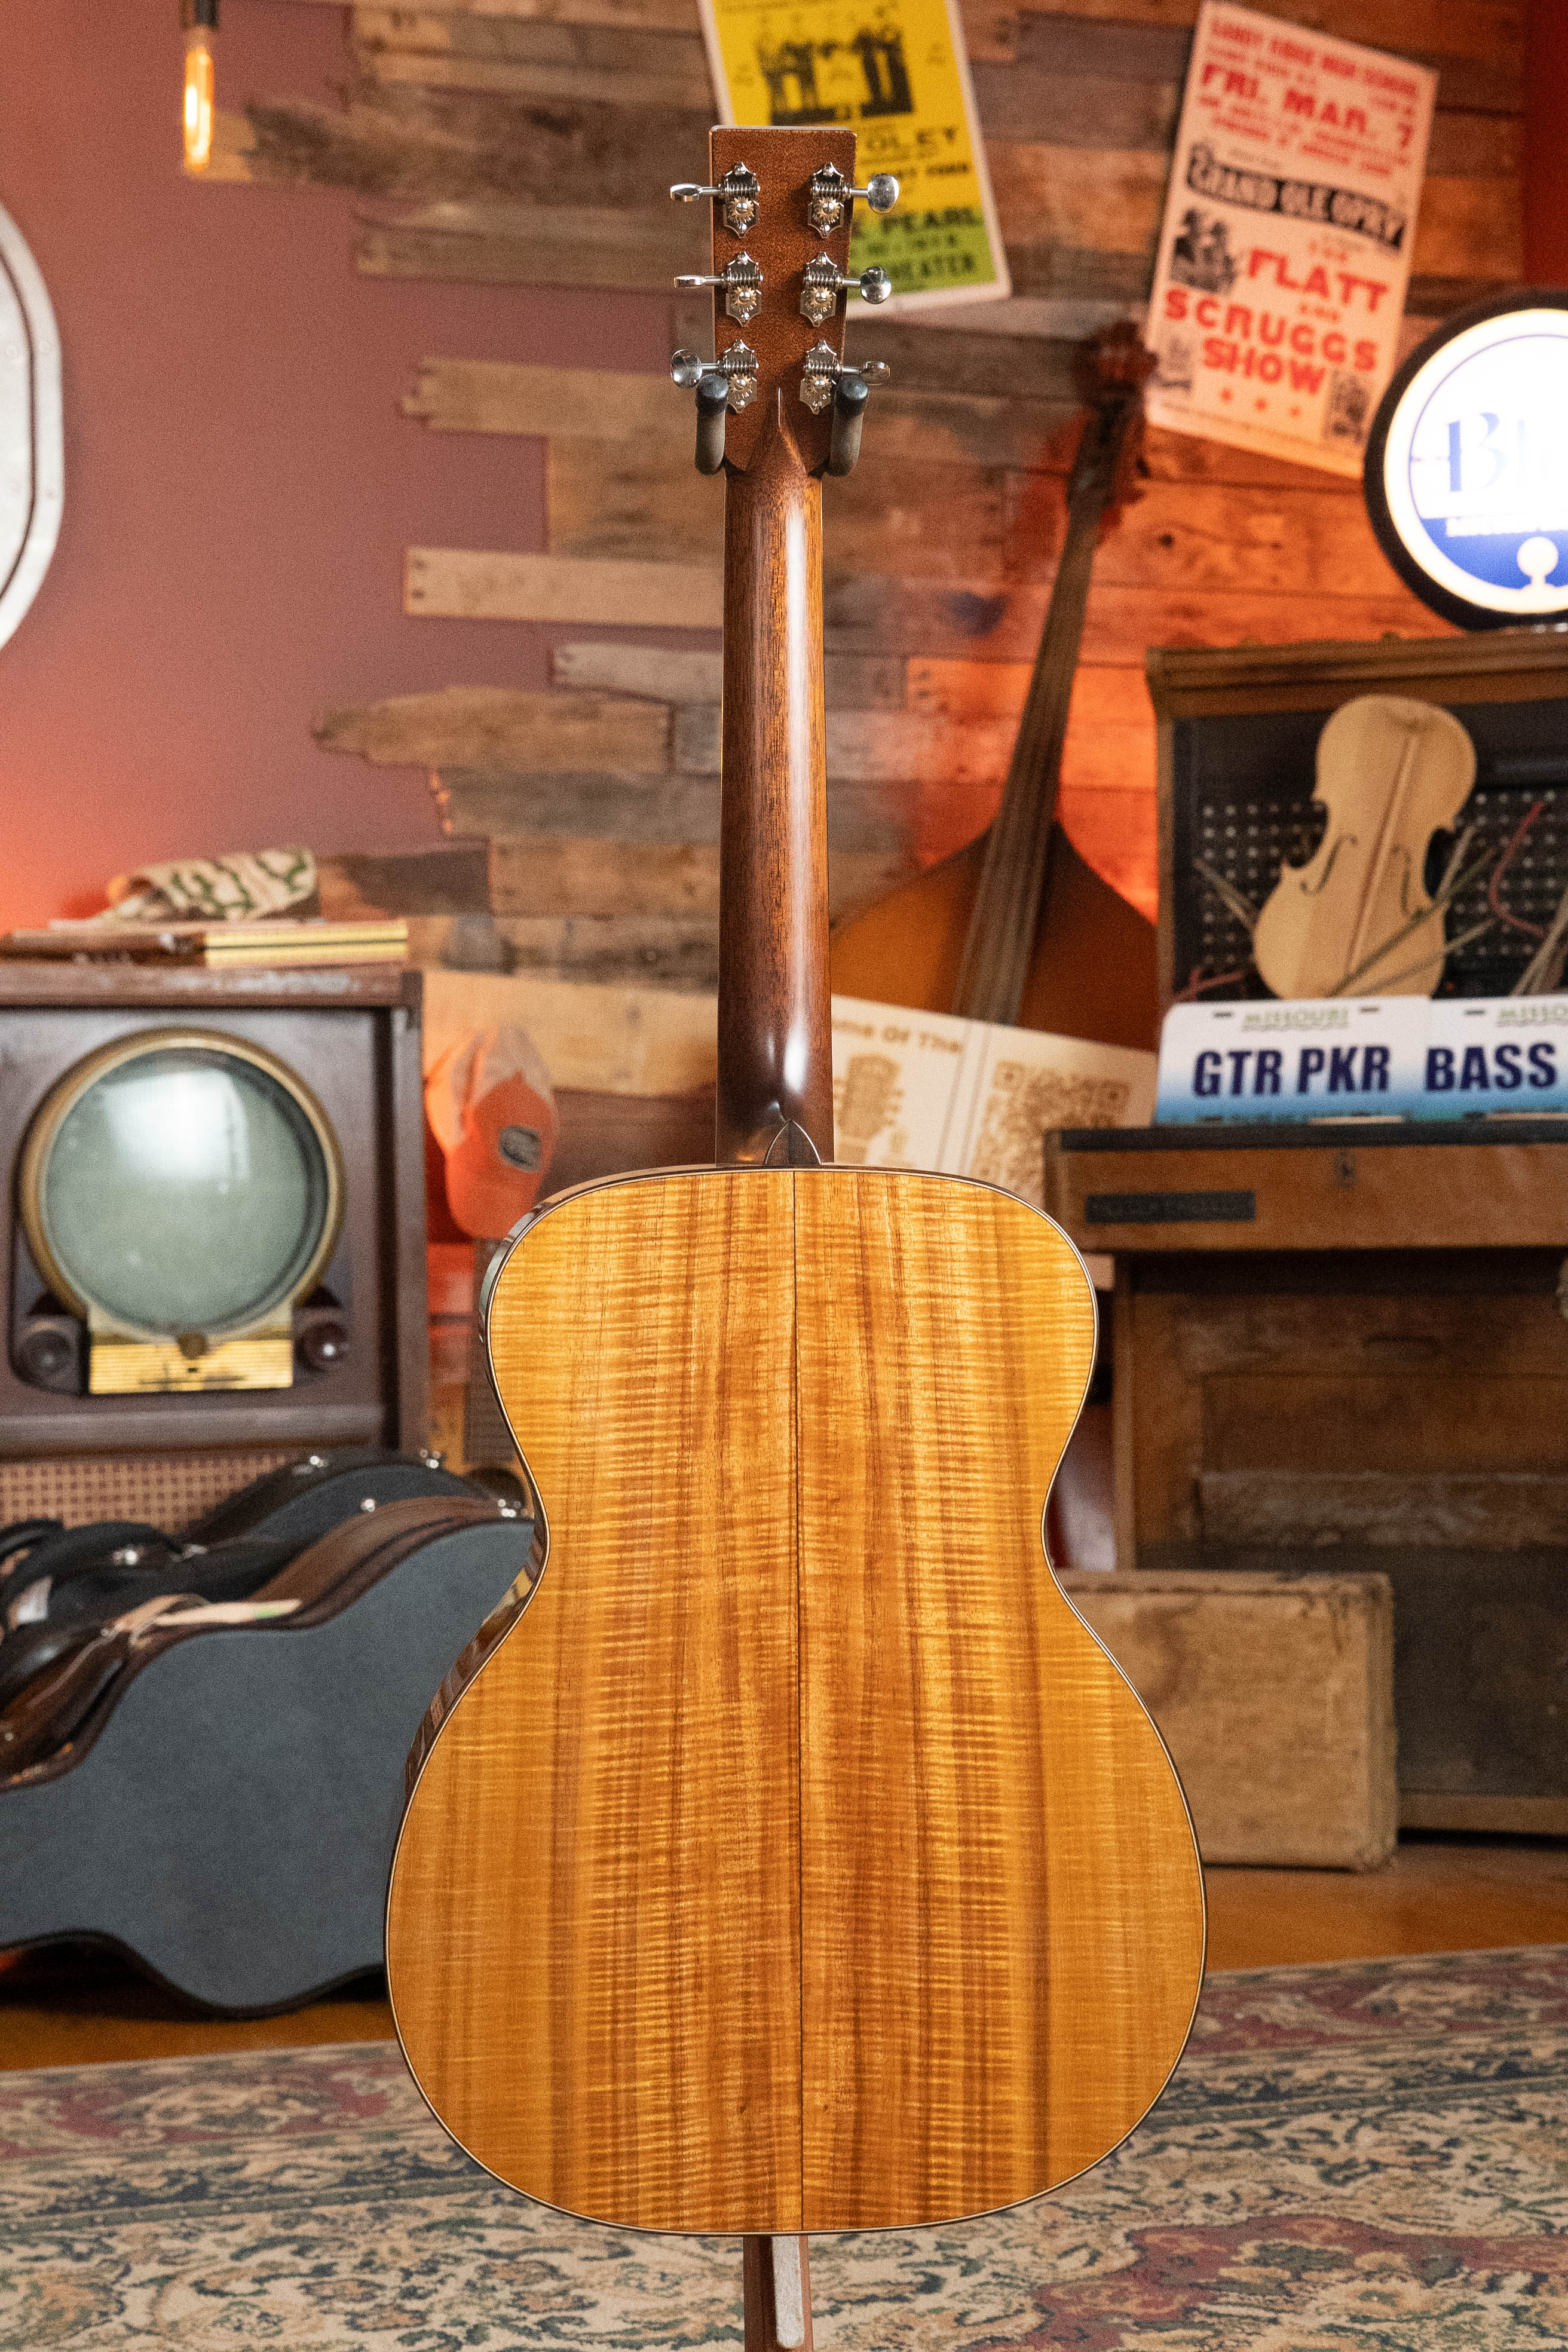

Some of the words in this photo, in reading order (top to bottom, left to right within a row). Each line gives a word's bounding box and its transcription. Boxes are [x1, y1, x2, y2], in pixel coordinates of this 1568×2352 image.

[1395, 121, 1414, 149] 7
[1279, 178, 1326, 221] OLE
[1248, 247, 1389, 314] FLATT
[1164, 288, 1379, 372] SCRUGGS
[1202, 337, 1327, 395] SHOW
[1193, 1048, 1284, 1099] GTR
[1296, 1043, 1391, 1095] PKR
[1424, 1041, 1558, 1092] BASS
